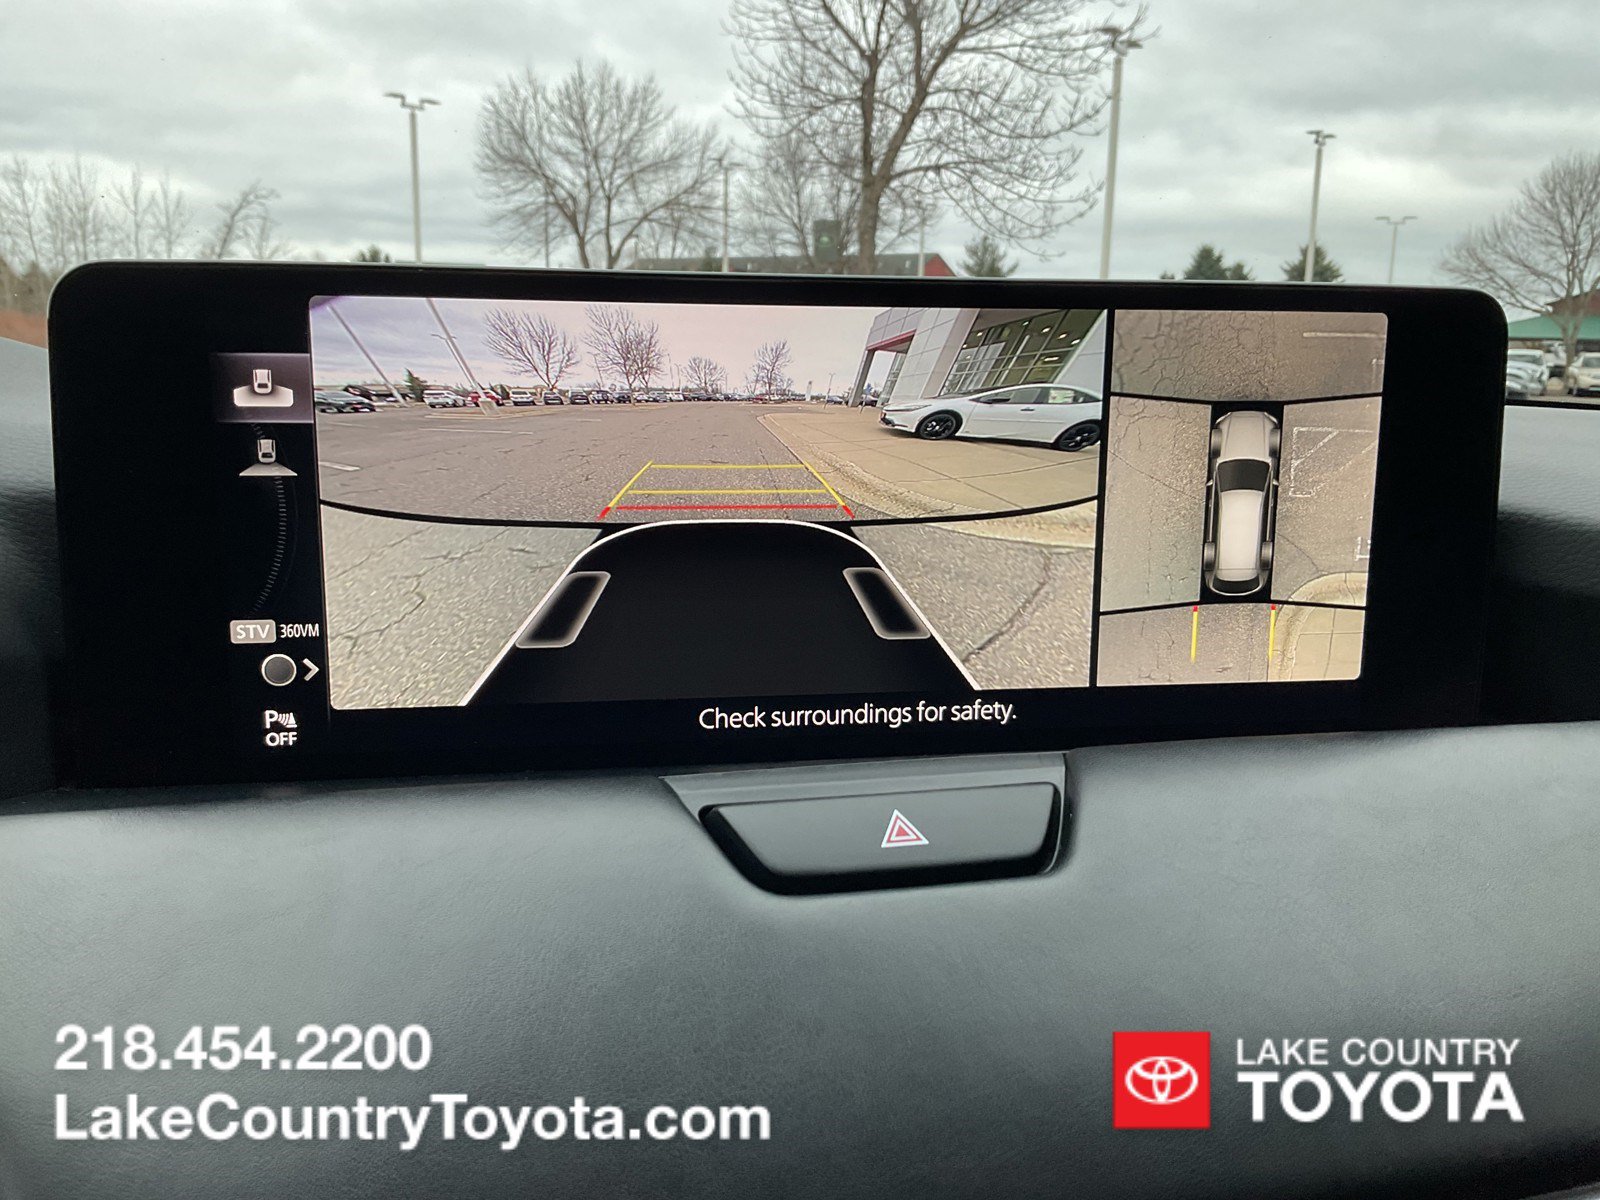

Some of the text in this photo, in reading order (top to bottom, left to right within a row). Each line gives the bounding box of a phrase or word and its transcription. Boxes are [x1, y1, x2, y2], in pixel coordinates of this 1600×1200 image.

[237, 624, 320, 639] STV 360VM
[699, 698, 1018, 729] Check surroundings for safety.
[266, 732, 298, 747] OFF
